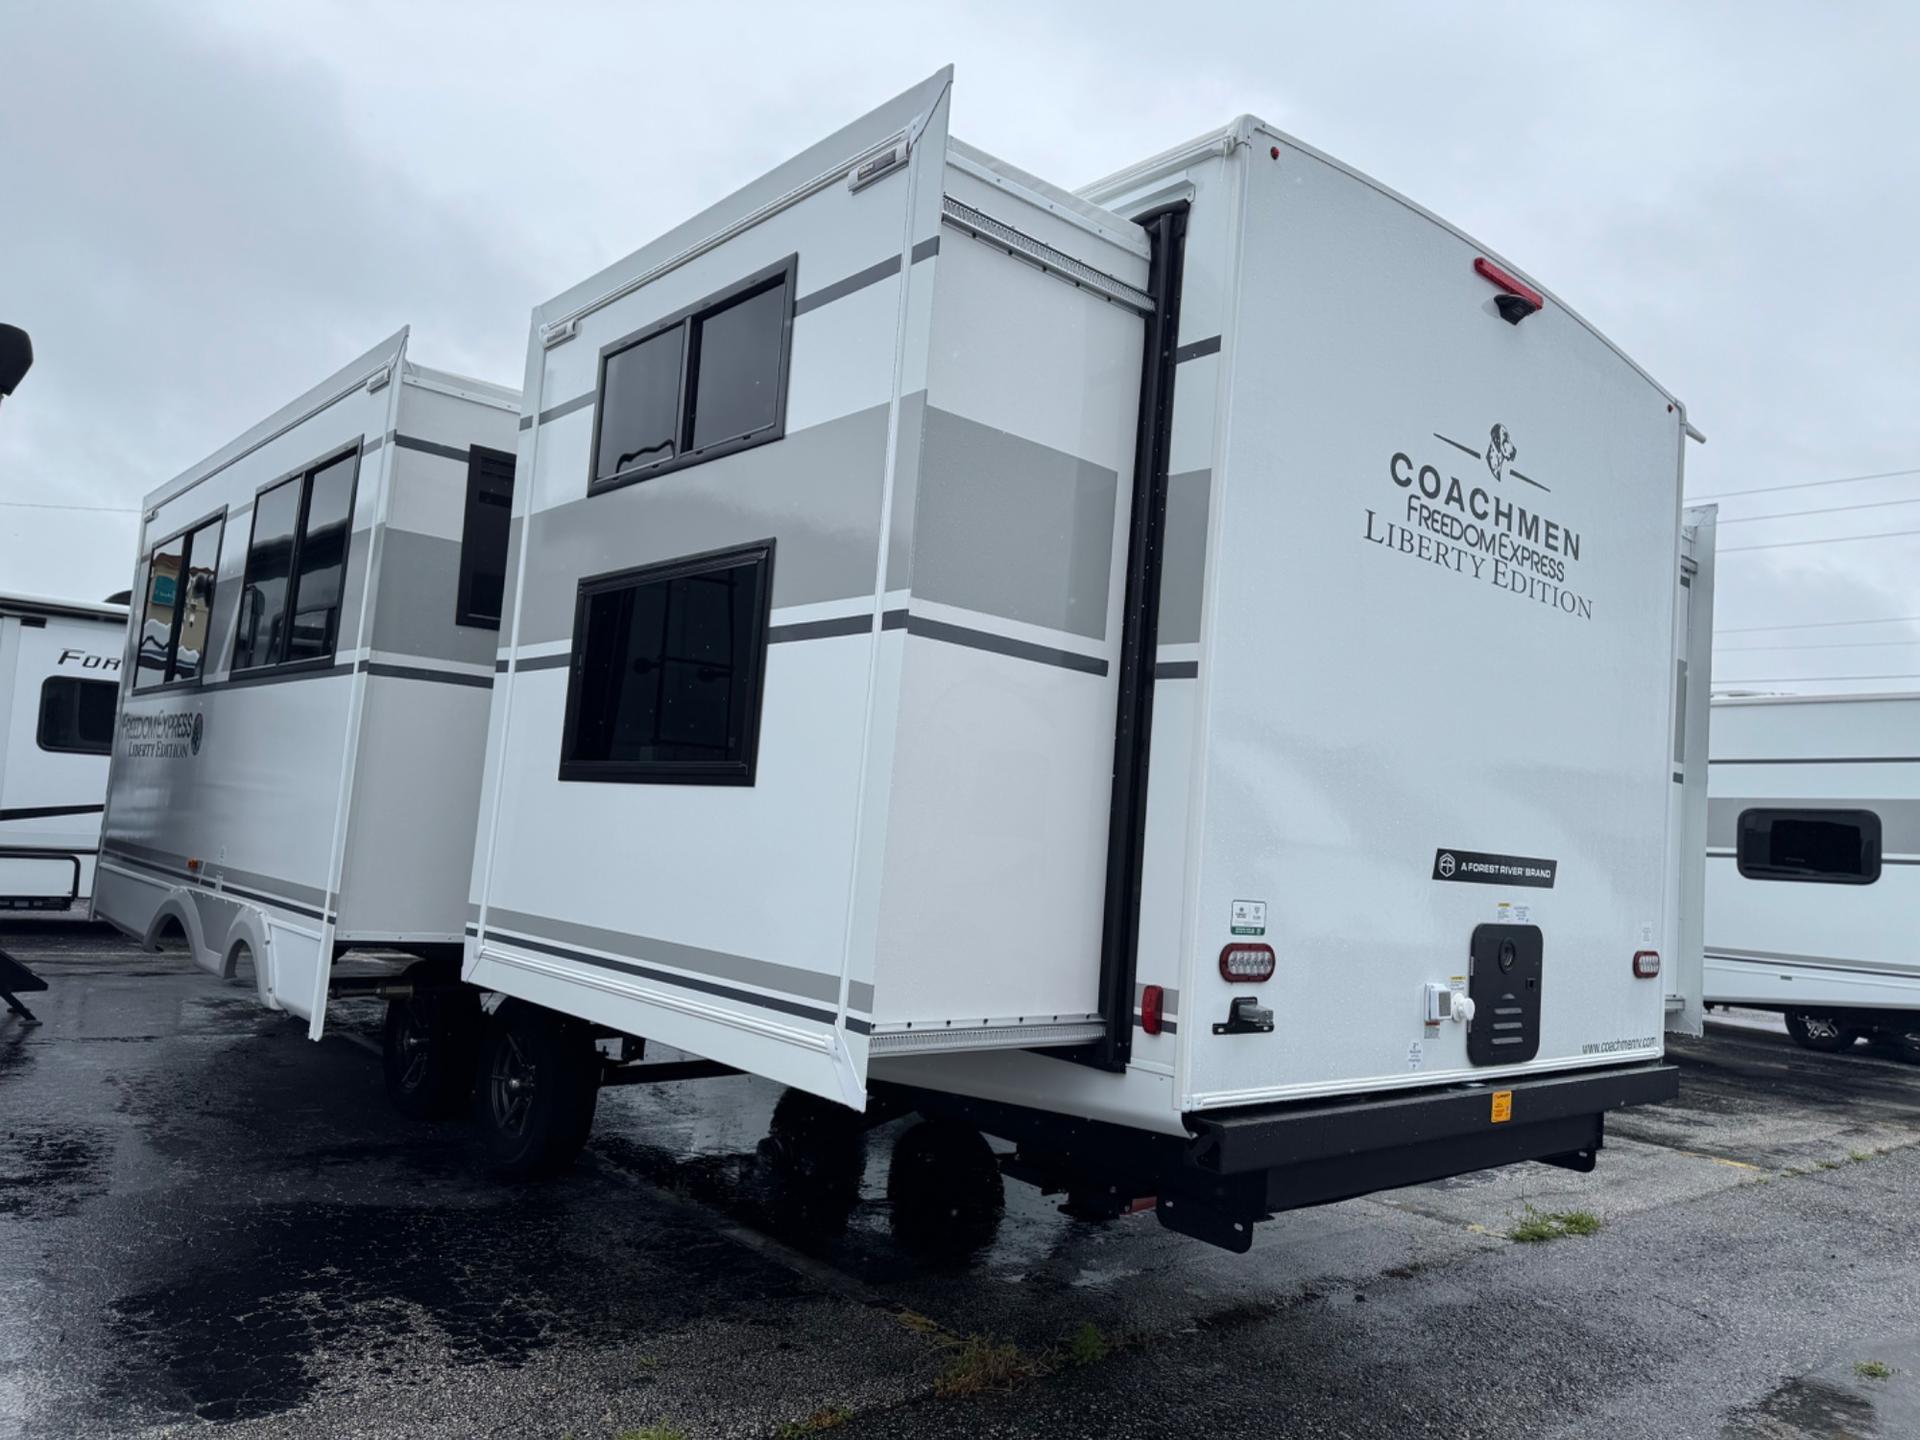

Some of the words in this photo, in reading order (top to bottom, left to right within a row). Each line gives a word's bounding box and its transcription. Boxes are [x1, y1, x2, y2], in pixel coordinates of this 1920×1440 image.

[1390, 451, 1581, 561] COACHMEN
[1363, 509, 1486, 580] LIBERTY
[1491, 557, 1593, 620] EDITION
[1460, 862, 1468, 871] A
[1468, 863, 1499, 874] FOREST
[1500, 865, 1523, 876] RIVER
[1525, 868, 1551, 878] BRAND
